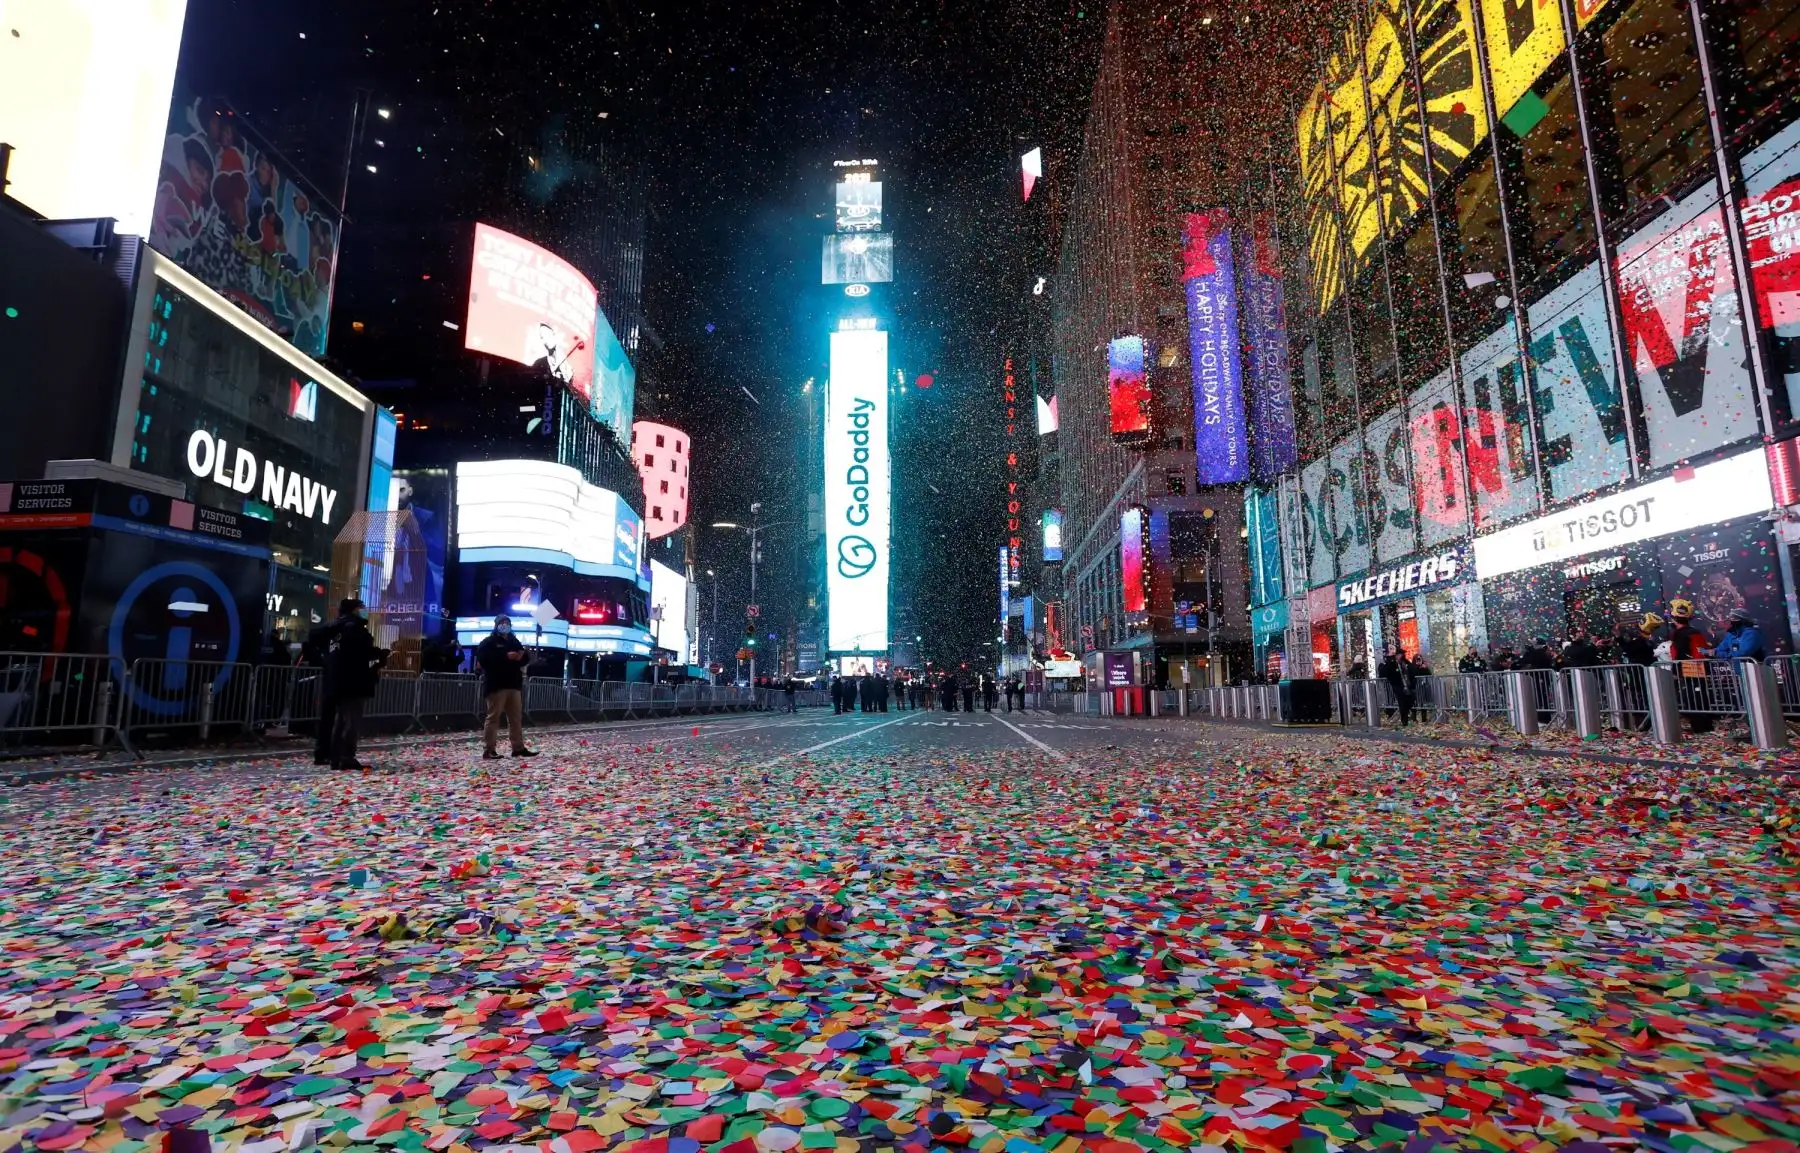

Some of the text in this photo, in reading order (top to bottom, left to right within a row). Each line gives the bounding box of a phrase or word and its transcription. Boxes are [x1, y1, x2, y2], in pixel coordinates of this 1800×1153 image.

[1195, 281, 1222, 425] HAPPY HOLIDAYS
[1004, 358, 1016, 434] ERNST
[846, 397, 876, 527] GoDaddy
[1008, 452, 1018, 466] &
[187, 429, 337, 525] OLD NAVY
[20, 484, 66, 496] VISITOR
[17, 498, 73, 509] SERVICES
[200, 509, 238, 526] VISITOR
[1562, 497, 1656, 543] TISSOT
[198, 521, 243, 540] SERVICES
[1577, 555, 1626, 577] TISSOT
[1694, 548, 1731, 563] TISSOT
[1338, 550, 1459, 608] SKECHERS
